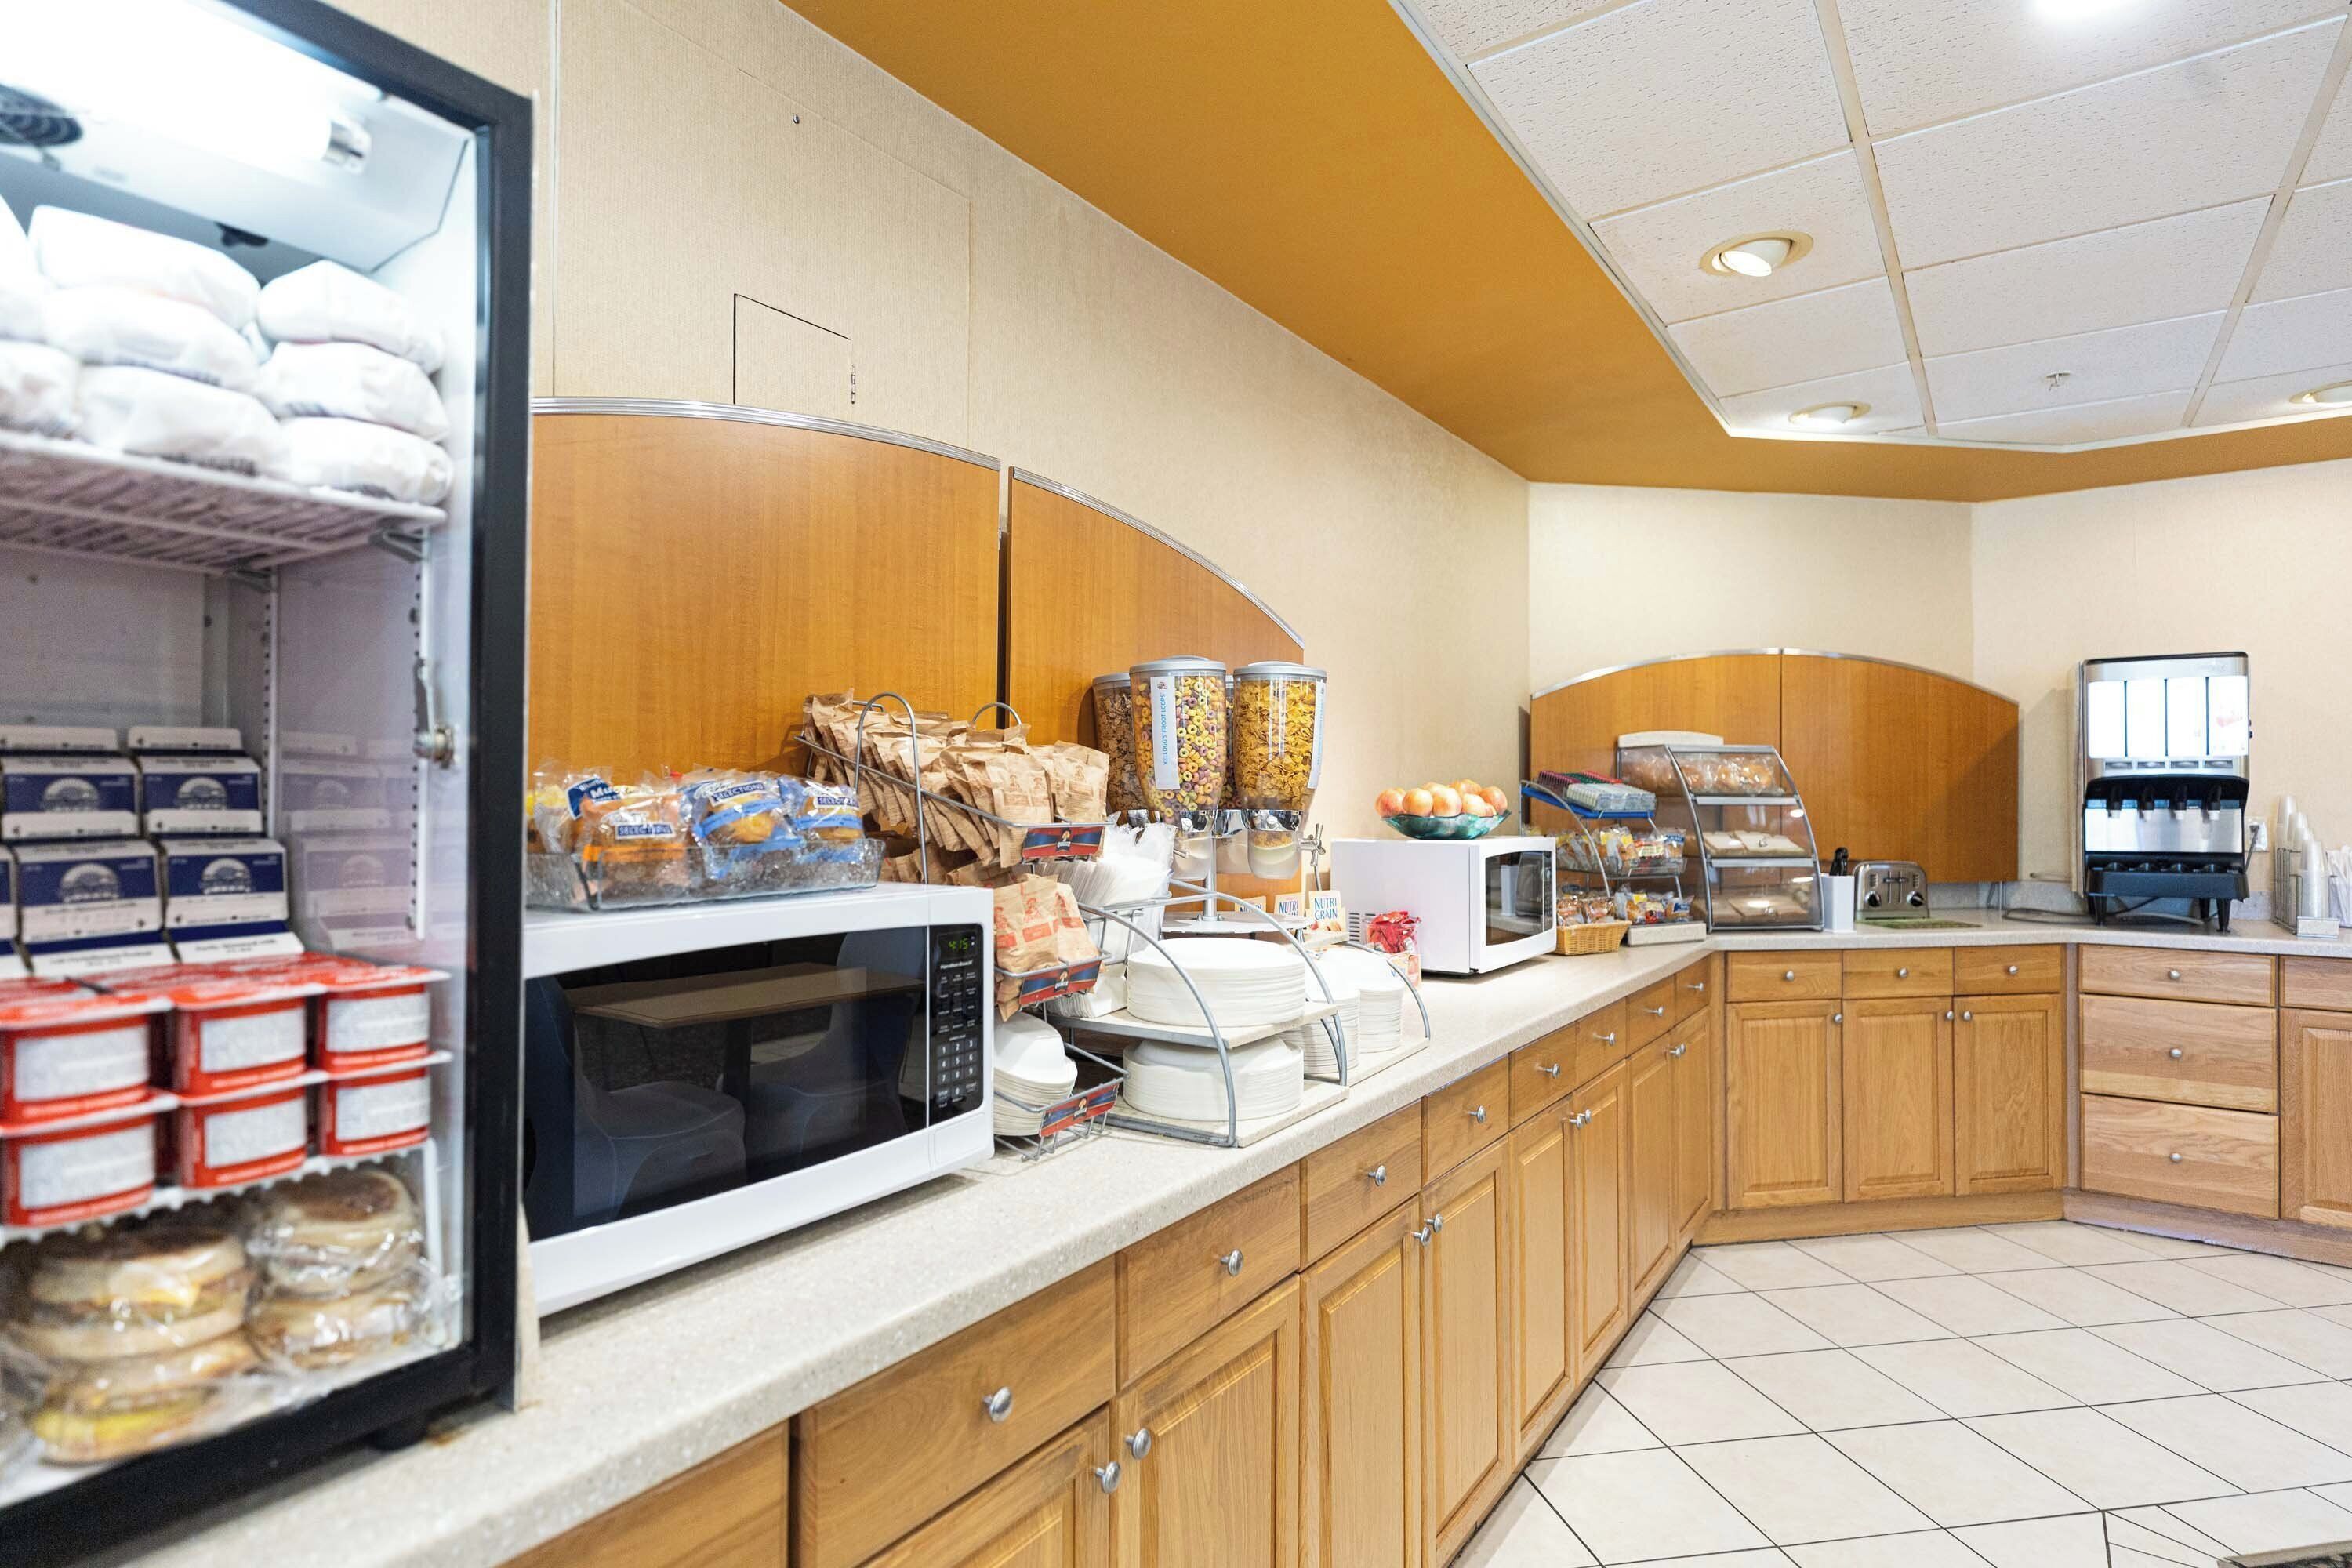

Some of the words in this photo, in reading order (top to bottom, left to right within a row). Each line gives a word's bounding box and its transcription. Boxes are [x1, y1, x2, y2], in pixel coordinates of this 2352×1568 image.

[1279, 900, 1298, 914] NUTRI
[1314, 897, 1337, 909] NUTRI
[1314, 909, 1338, 920] GRAIN
